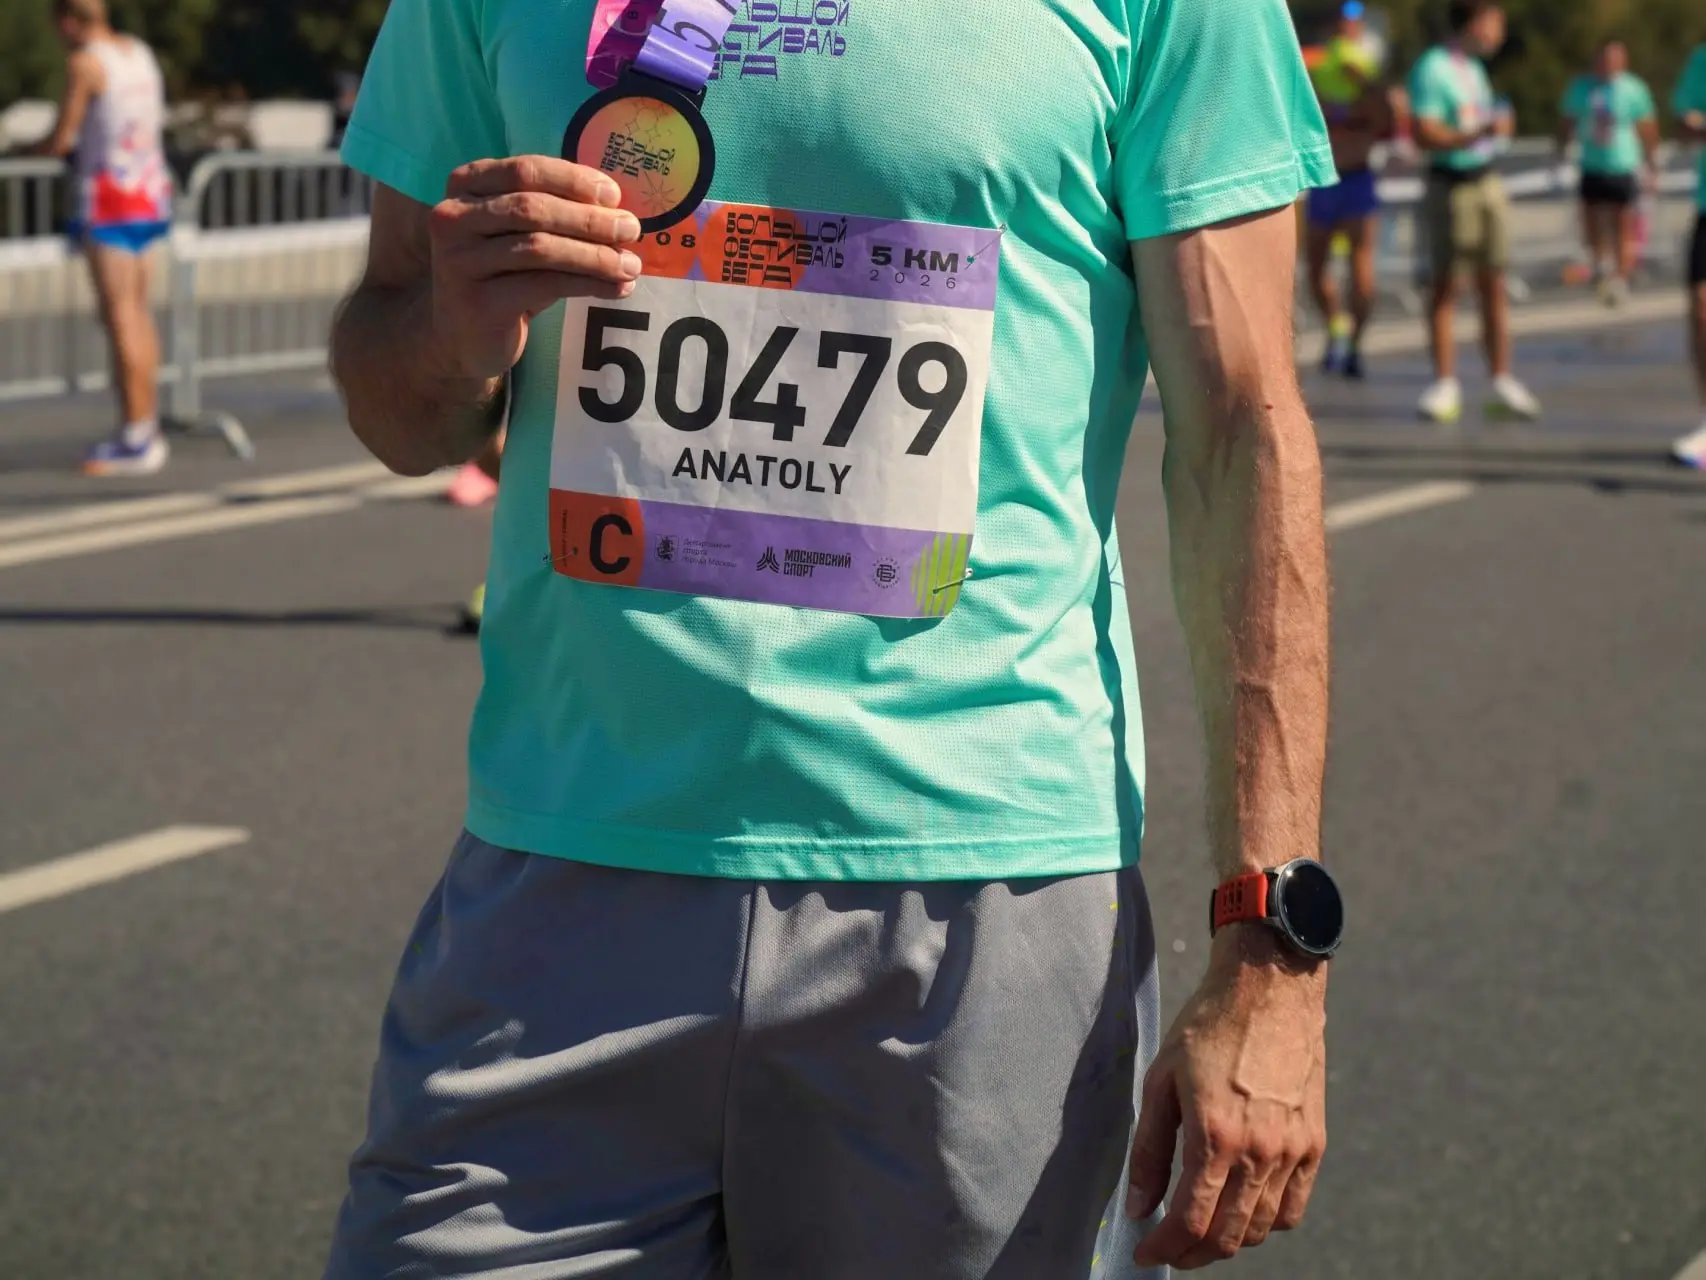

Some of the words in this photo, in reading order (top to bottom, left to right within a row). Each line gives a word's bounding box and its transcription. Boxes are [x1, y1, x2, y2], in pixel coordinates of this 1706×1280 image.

[655, 8, 721, 53] 5
[722, 23, 847, 57] СТИВАЛЬ
[708, 53, 778, 81] ЕГА
[726, 212, 848, 244] БОЛЬШОЙ
[723, 236, 845, 269] ФЕСТИВАЛЬ
[870, 245, 893, 266] 5
[721, 260, 792, 288] БЕГА
[868, 268, 957, 290] 2026
[578, 305, 968, 457] 50479
[671, 446, 853, 495] ANATOLY
[589, 513, 633, 575] C
[784, 548, 852, 569] МОСКОВСКИЙ
[783, 562, 815, 578] СПОРТ
